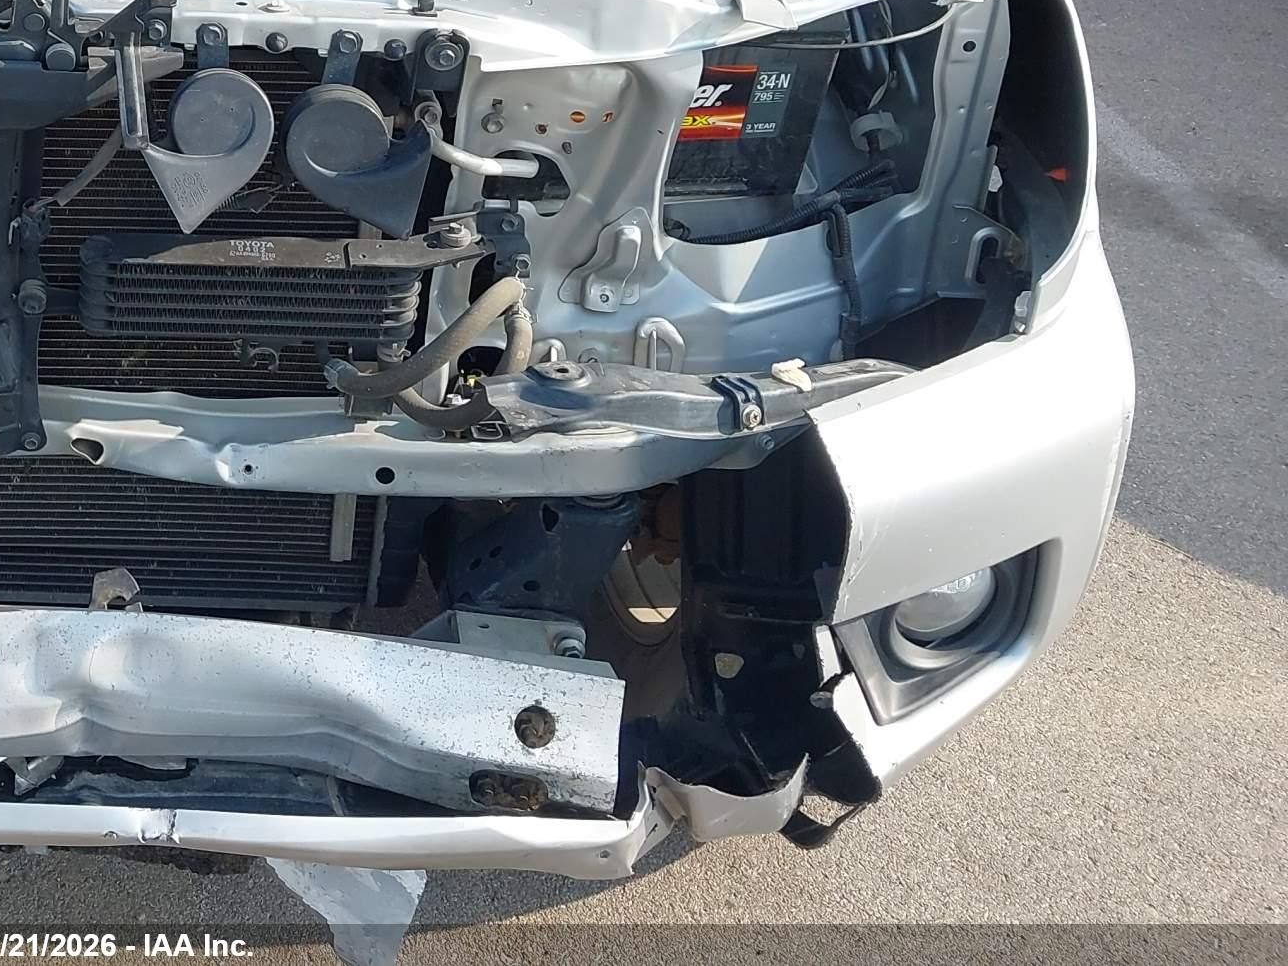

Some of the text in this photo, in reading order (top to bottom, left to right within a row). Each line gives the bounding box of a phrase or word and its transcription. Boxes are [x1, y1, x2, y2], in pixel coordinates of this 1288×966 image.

[756, 73, 791, 90] 34-N
[753, 91, 774, 101] 795
[753, 122, 776, 130] YEAR
[229, 240, 275, 249] TOYOTA
